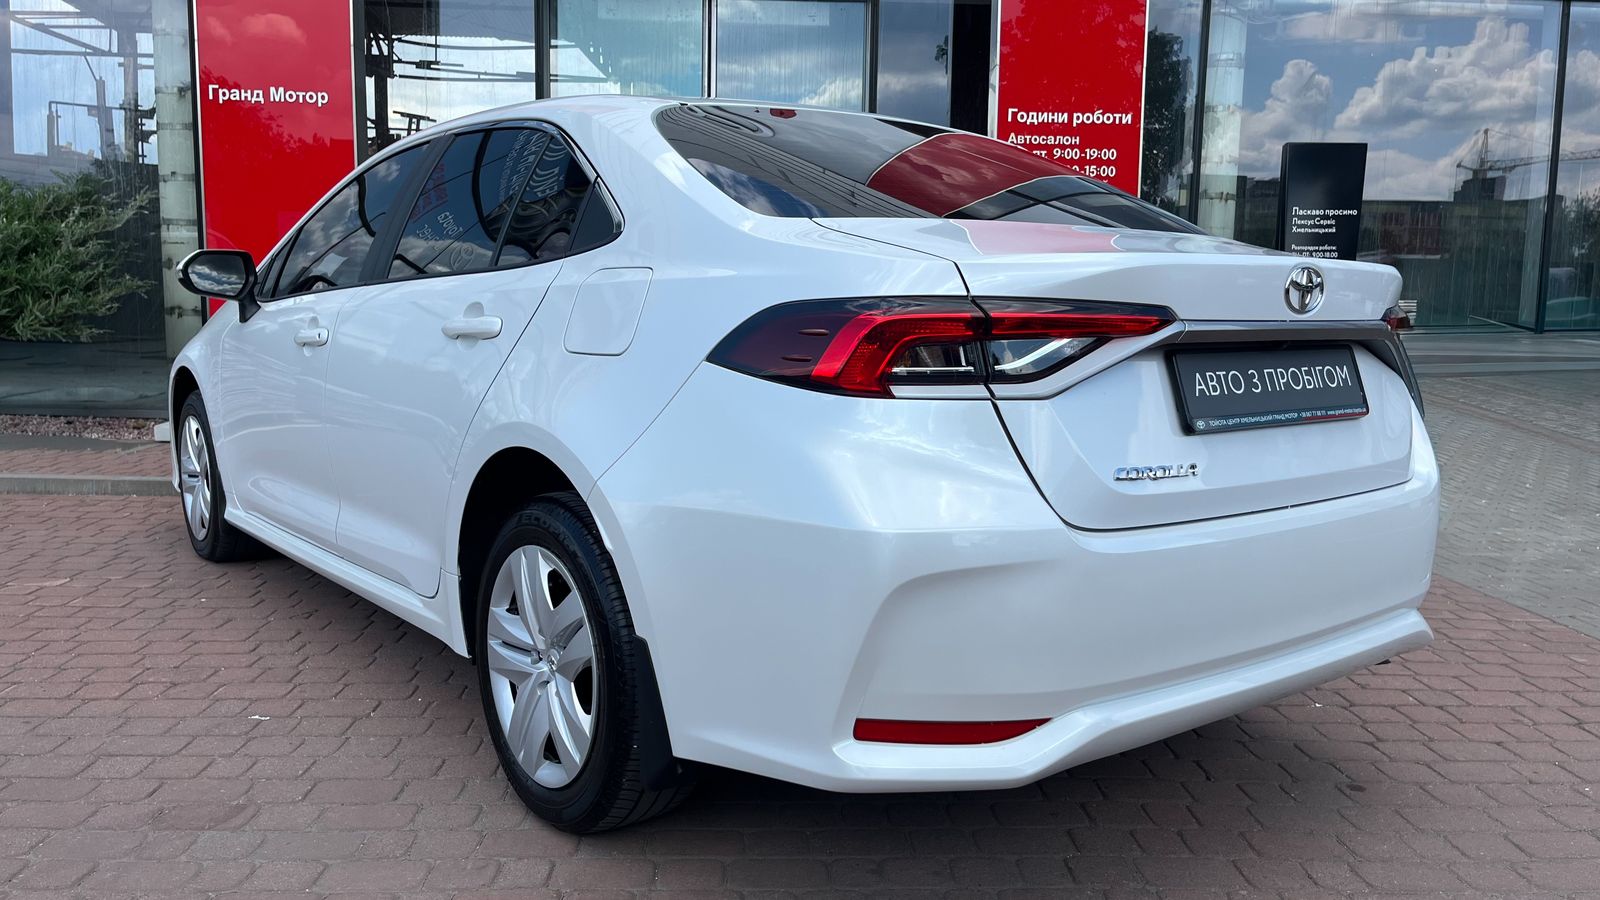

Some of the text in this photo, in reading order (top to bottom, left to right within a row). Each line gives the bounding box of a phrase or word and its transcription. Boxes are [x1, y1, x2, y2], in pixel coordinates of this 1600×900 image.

[208, 84, 329, 107] Гранд Мотор
[1007, 108, 1132, 127] Години роботи
[1007, 132, 1080, 145] Автосалон
[1053, 148, 1117, 160] 9:00-19:00
[1325, 209, 1358, 217] просимо
[1195, 365, 1352, 397] АВТО З ПРОБІГОМ
[1113, 463, 1199, 481] COROLLA
